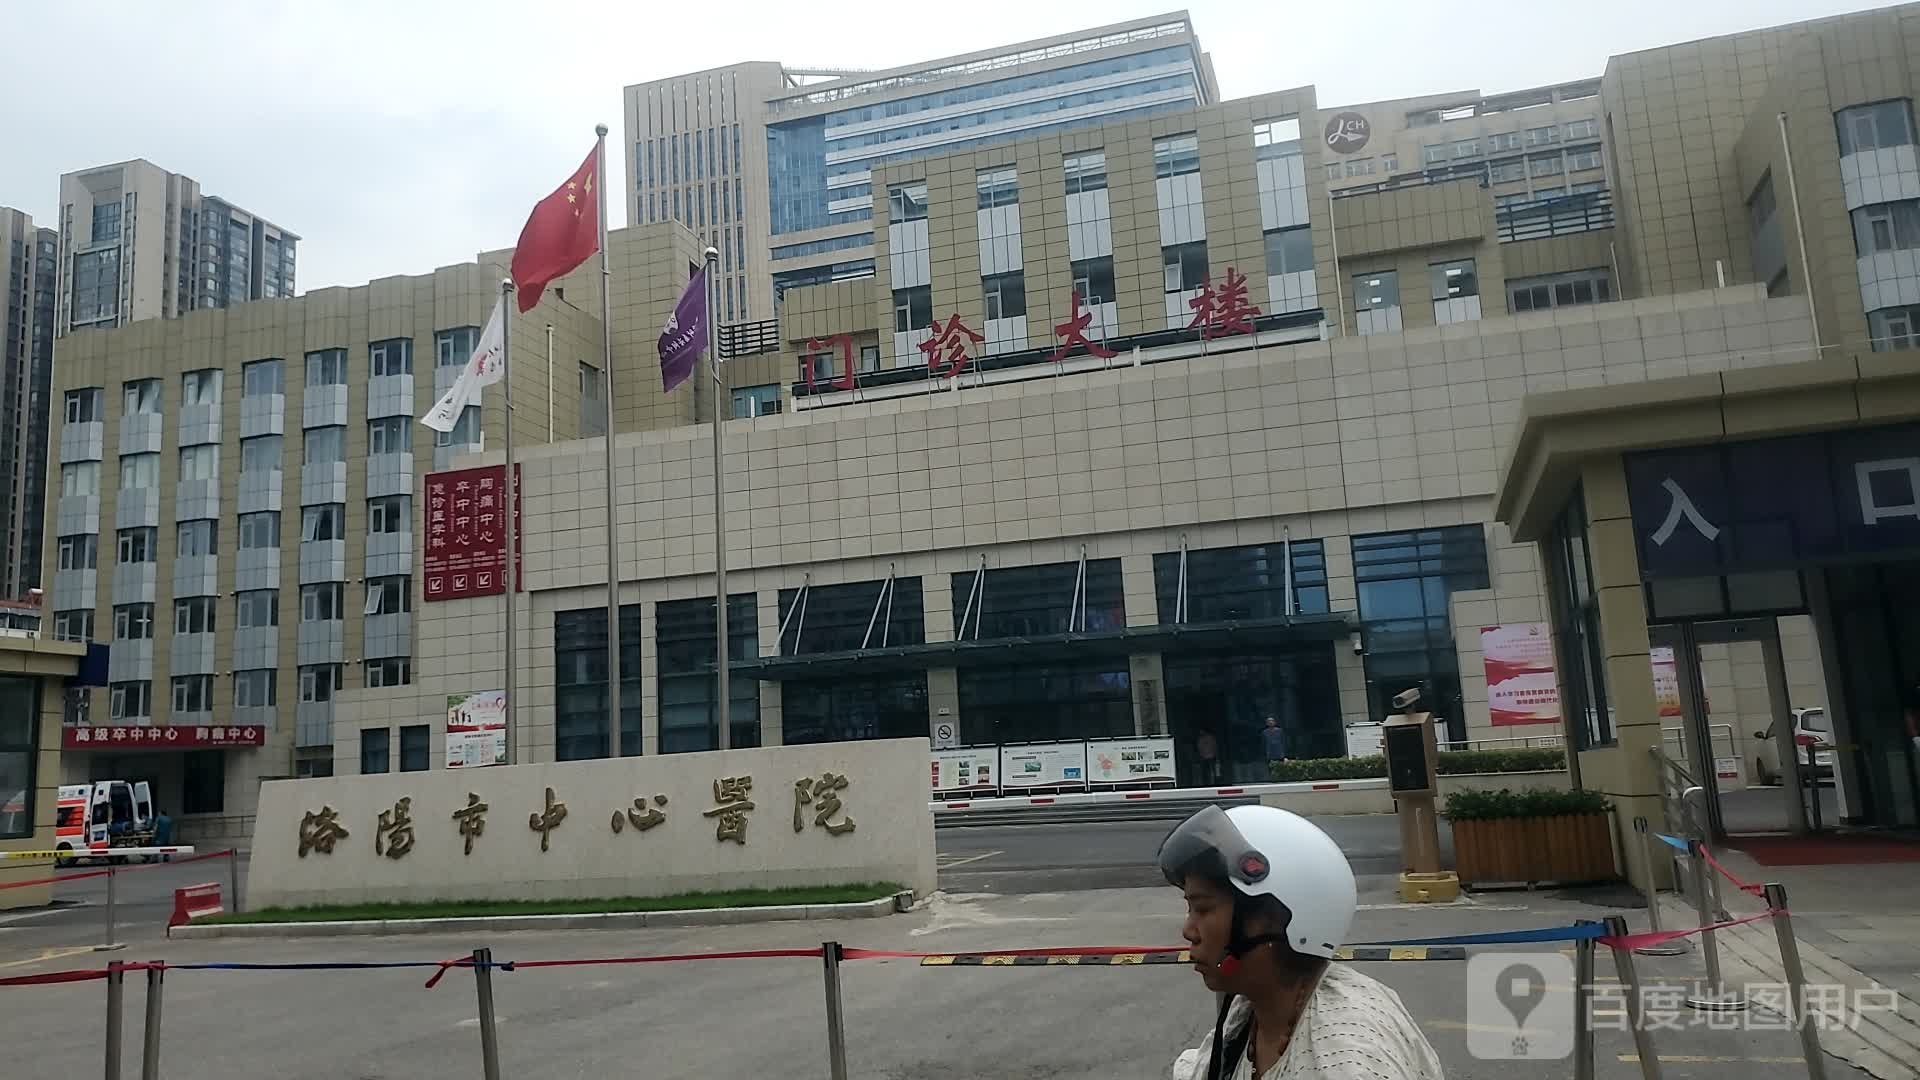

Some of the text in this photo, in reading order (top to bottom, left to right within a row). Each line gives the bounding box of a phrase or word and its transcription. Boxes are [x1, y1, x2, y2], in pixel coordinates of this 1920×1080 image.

[806, 267, 1261, 390] 门诊大楼
[431, 483, 446, 548] 急诊医学科
[456, 481, 470, 545] 卒中中心
[479, 477, 495, 543] 胸痛中心
[1650, 457, 1920, 546] 入口
[76, 728, 178, 742] 高级卒中中心
[196, 727, 256, 740] 胸痛中心
